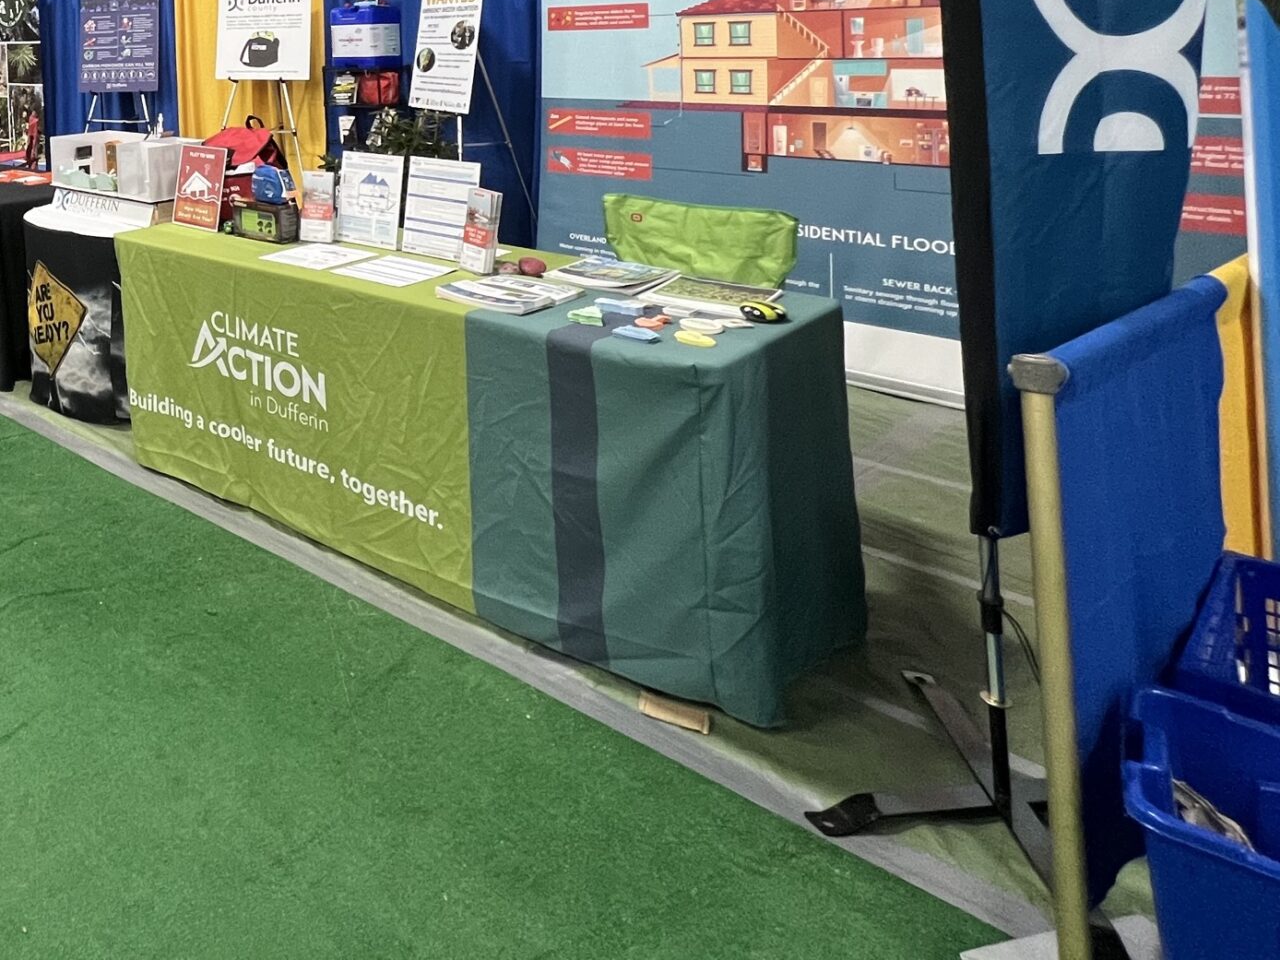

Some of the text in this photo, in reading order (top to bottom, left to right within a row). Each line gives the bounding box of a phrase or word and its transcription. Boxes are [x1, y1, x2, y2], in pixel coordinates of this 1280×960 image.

[70, 190, 120, 212] DUFFERIN
[569, 232, 608, 245] OVERLAND
[796, 223, 887, 249] SIDENTIAL
[807, 281, 820, 289] the
[881, 278, 921, 291] SEWER
[210, 310, 300, 358] CLIMATE
[186, 319, 327, 412] ACTION
[249, 390, 330, 433] in Dufferin
[128, 387, 444, 530] Building a cooler future, together.
